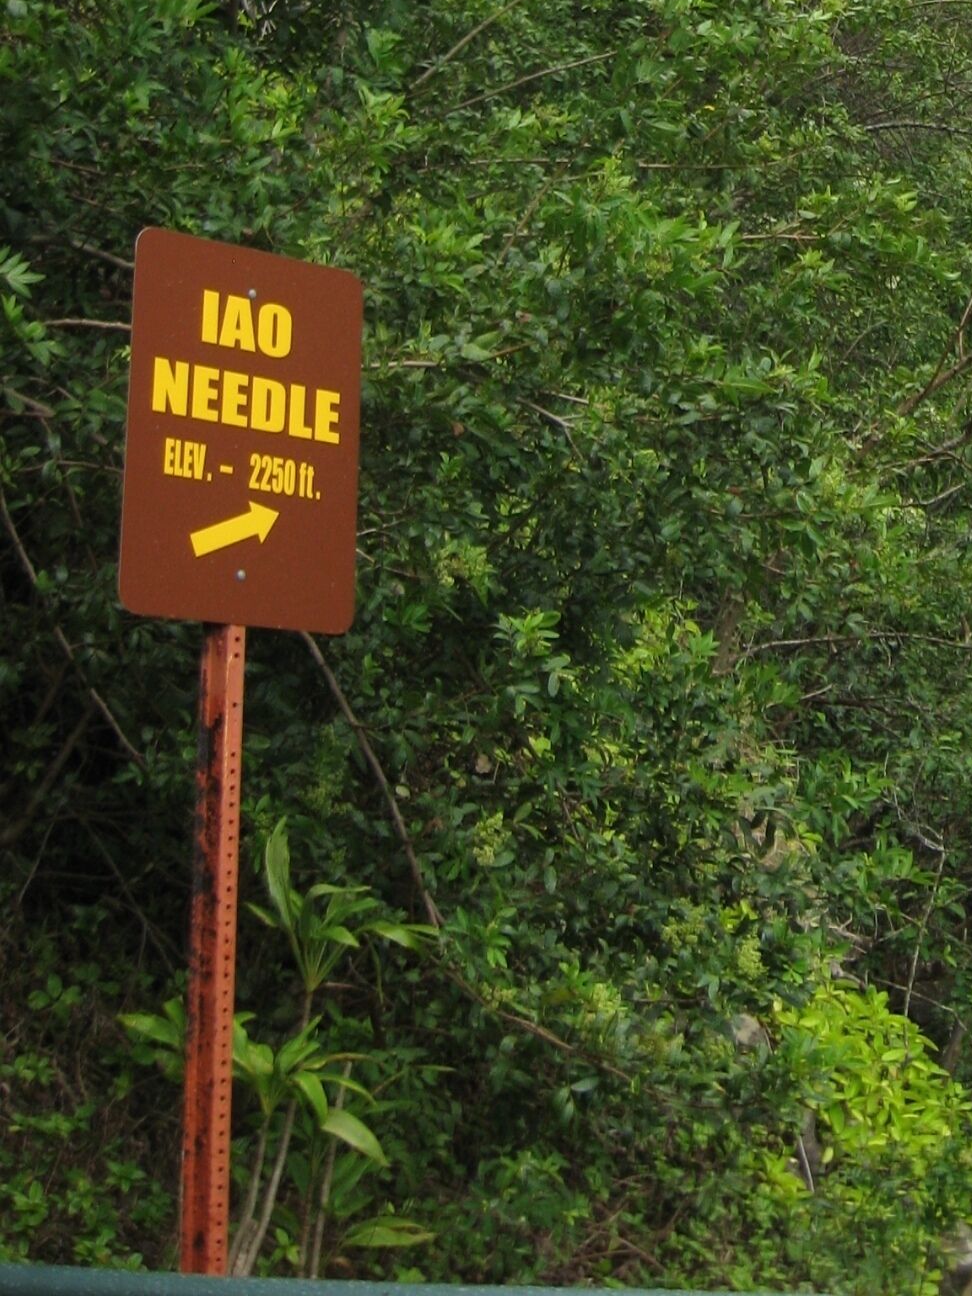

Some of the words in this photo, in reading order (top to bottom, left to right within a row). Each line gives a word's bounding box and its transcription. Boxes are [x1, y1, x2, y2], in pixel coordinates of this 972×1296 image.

[201, 290, 293, 357] IAO
[152, 357, 340, 445] NEEDLE
[164, 438, 212, 481] ELEV.
[249, 453, 296, 496] 2250
[299, 463, 321, 499] ft.
